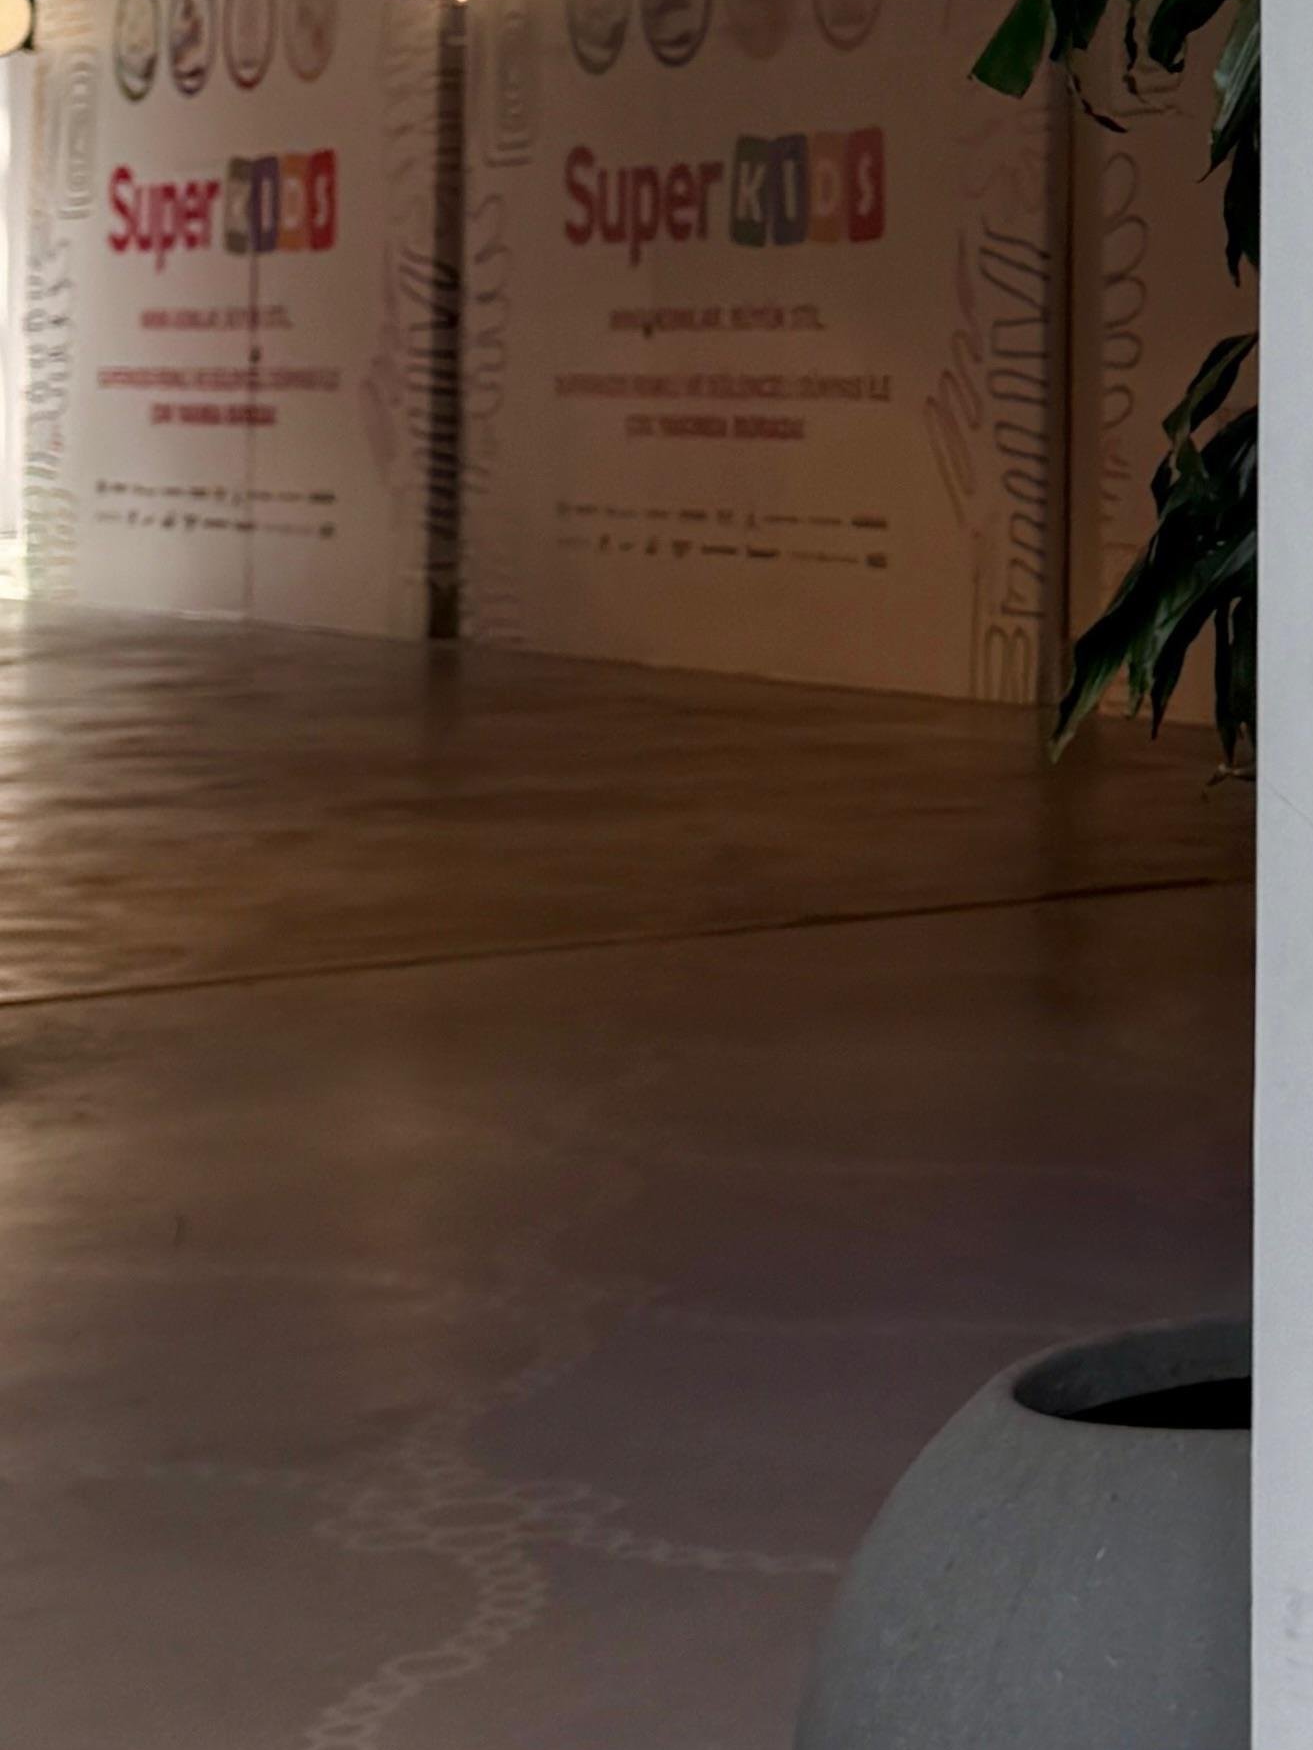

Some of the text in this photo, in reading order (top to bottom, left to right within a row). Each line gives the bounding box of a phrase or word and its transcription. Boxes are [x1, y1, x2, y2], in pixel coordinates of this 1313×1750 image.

[109, 164, 221, 273] Super
[565, 144, 879, 266] Super KIDS
